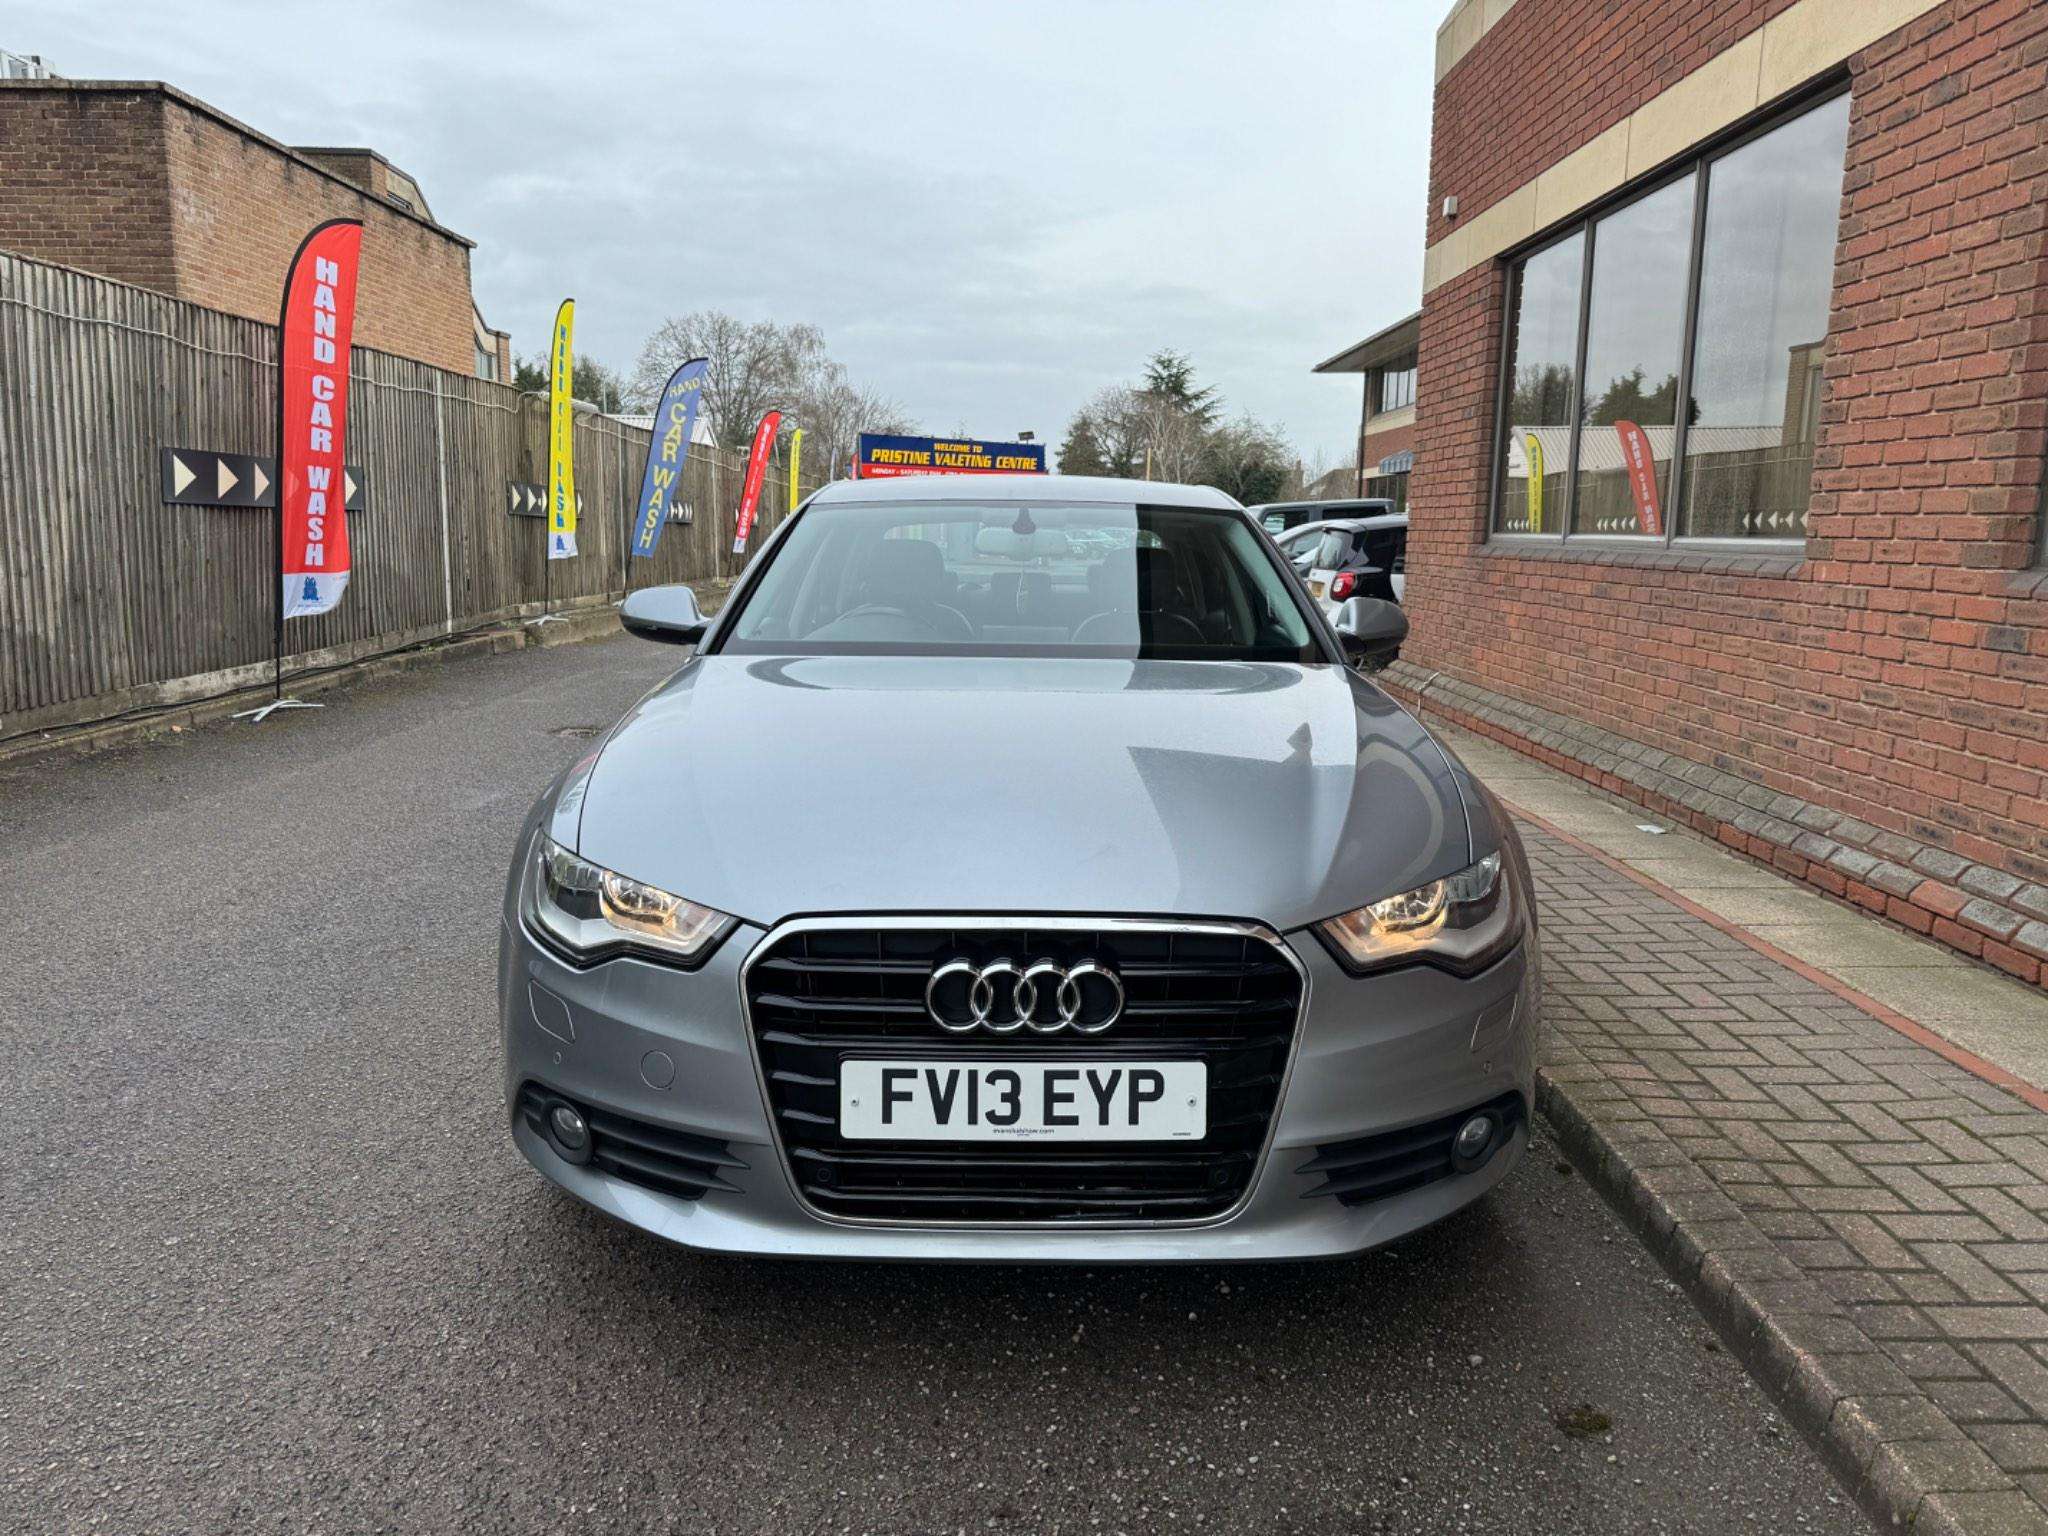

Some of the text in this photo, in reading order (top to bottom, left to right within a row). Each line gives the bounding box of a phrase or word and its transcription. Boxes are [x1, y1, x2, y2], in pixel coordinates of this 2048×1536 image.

[305, 256, 338, 566] HAND CAR WASH
[639, 376, 701, 549] HAND CAR WASH
[872, 449, 1037, 470] PRISTINE VALETING CENTRE
[934, 443, 983, 453] WELCOME TO
[881, 1068, 1166, 1126] FV13 EYP
